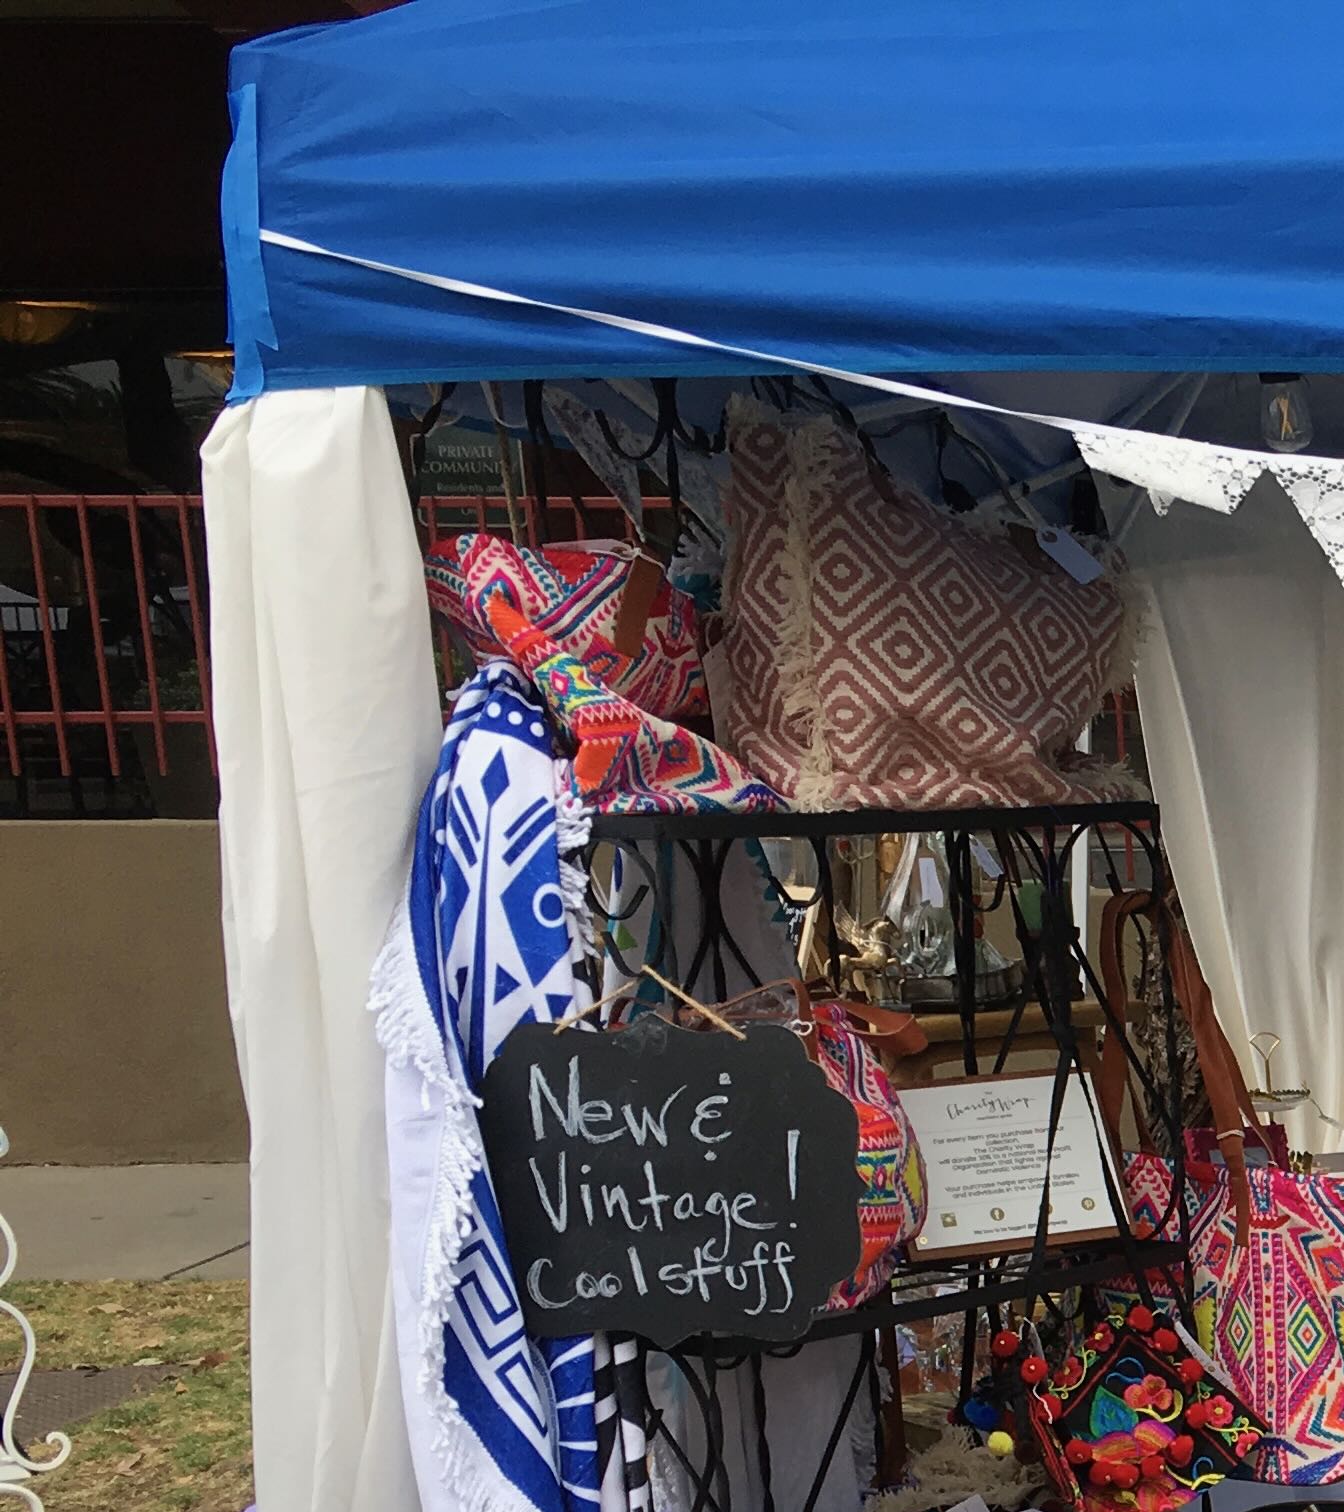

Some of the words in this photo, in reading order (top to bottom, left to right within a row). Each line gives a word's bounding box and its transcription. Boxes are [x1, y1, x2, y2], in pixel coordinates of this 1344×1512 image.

[438, 445, 494, 458] PRIVATE
[421, 461, 516, 474] COMMUNI
[528, 1055, 687, 1147] New
[690, 1072, 732, 1161] &
[946, 1097, 996, 1120] Charity
[998, 1096, 1036, 1112] Wrap
[990, 1144, 1014, 1154] Charity
[1014, 1142, 1035, 1151] Wrap
[526, 1246, 648, 1310] Cool
[658, 1241, 796, 1315] stuff
